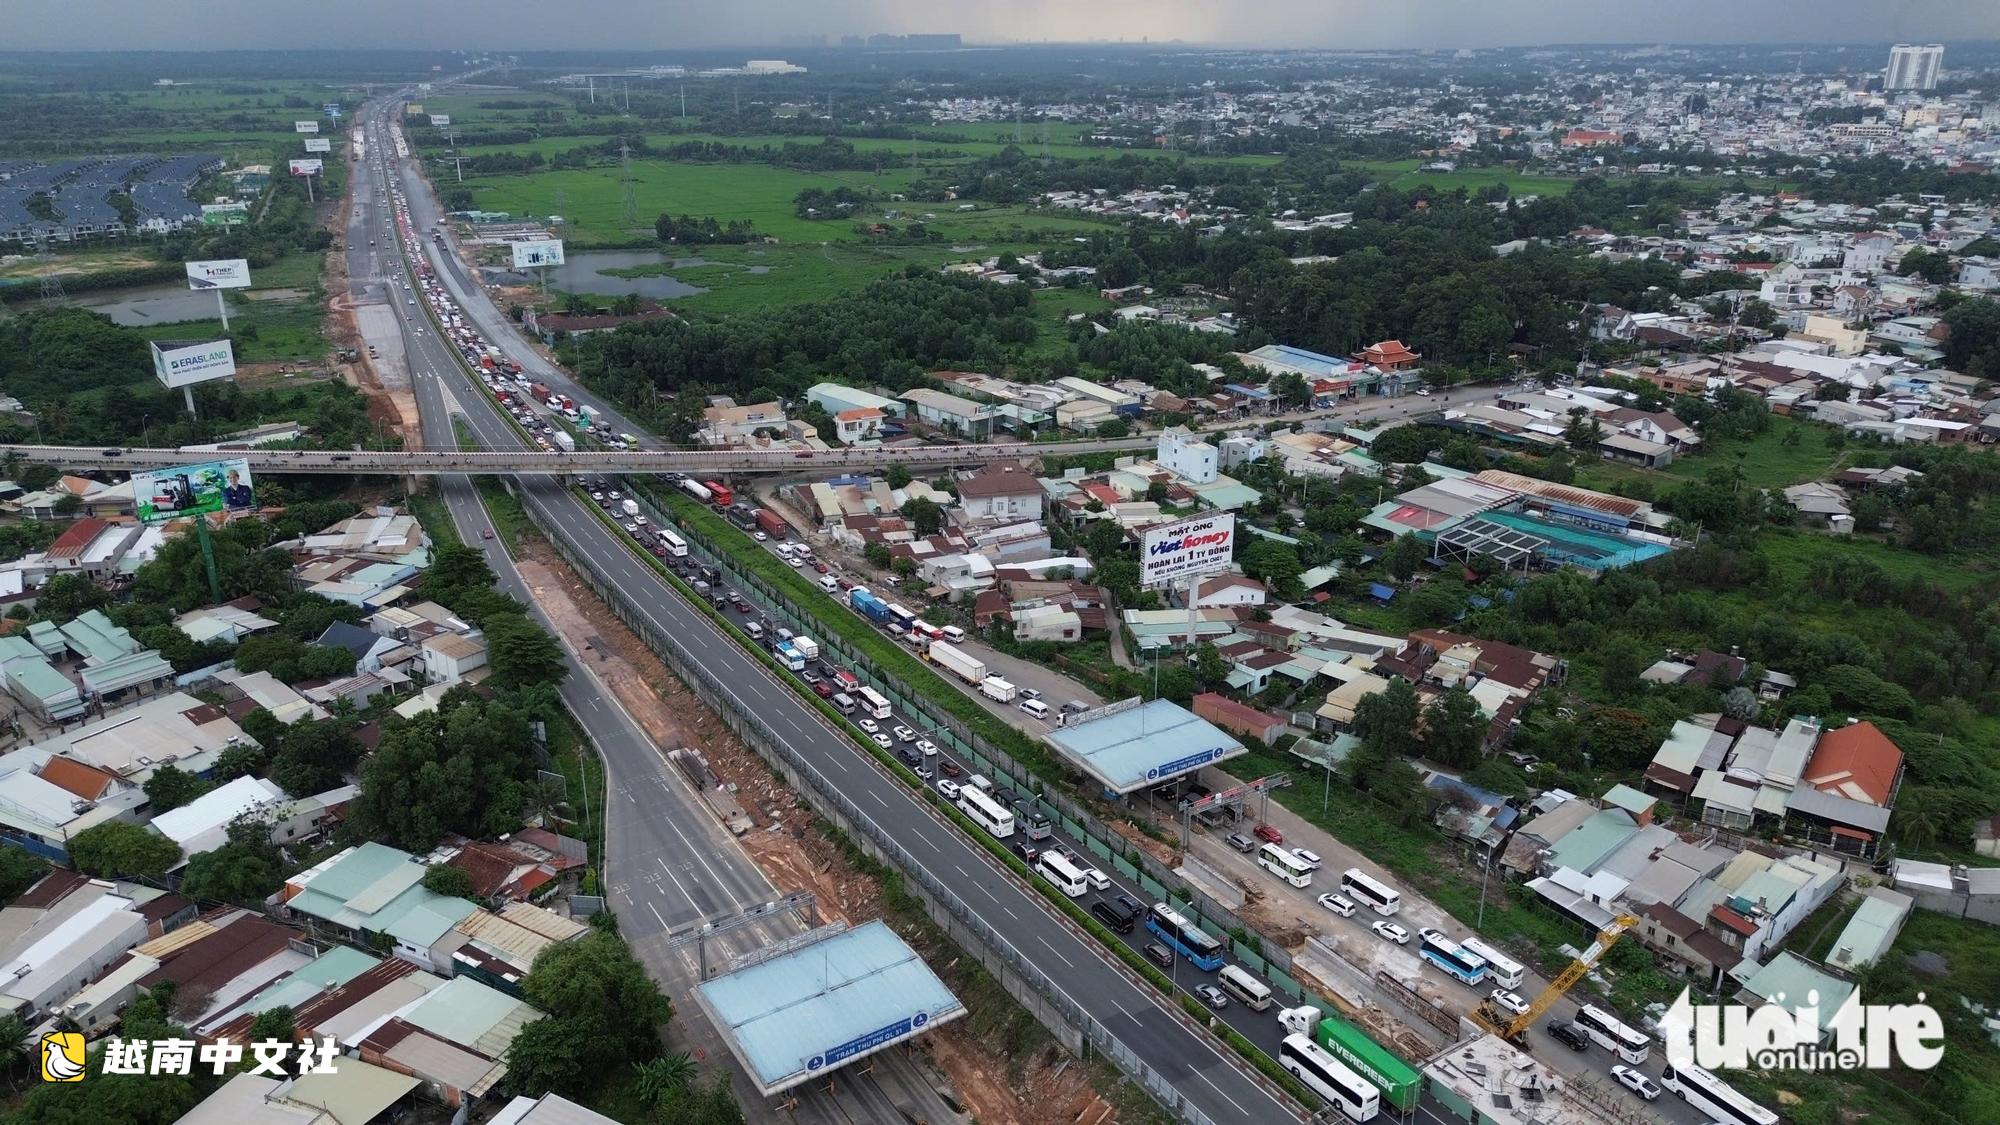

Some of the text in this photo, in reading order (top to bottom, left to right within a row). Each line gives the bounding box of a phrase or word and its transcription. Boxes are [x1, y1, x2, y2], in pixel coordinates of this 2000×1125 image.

[180, 351, 227, 367] ERASLAND
[1188, 550, 1194, 560] 1
[858, 1041, 871, 1050] THU
[885, 1032, 894, 1040] QL
[896, 1028, 902, 1036] 51
[1328, 1038, 1393, 1093] EVERGREEN
